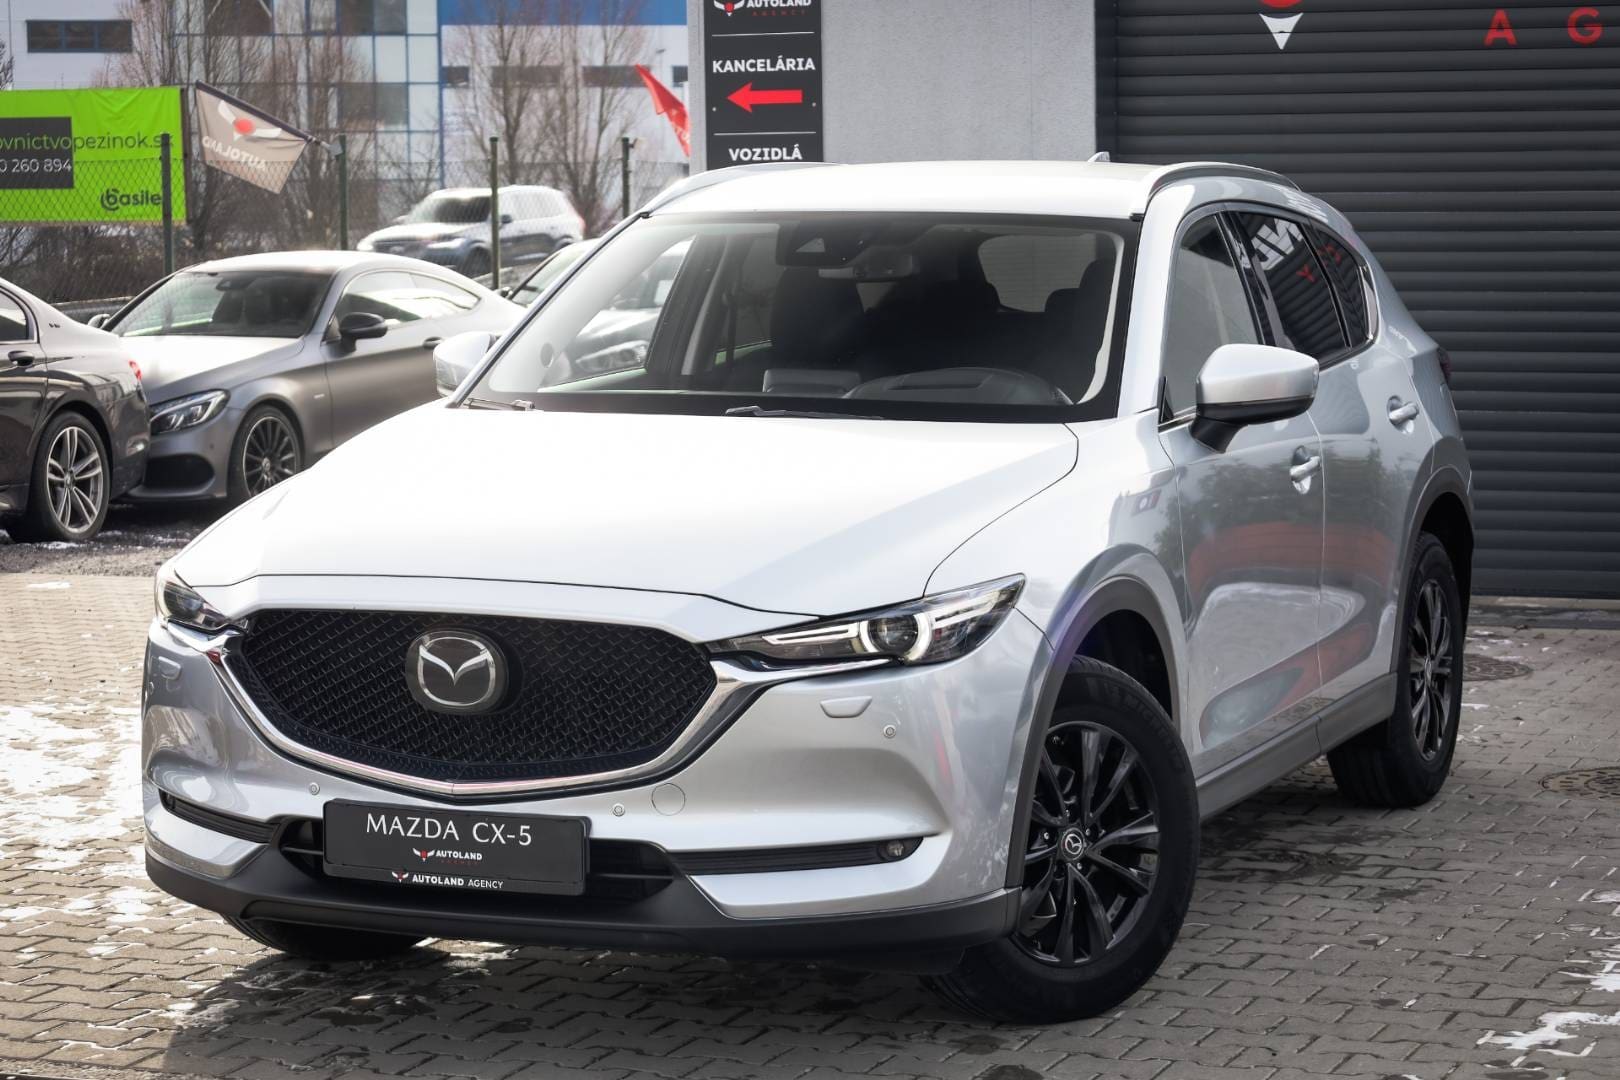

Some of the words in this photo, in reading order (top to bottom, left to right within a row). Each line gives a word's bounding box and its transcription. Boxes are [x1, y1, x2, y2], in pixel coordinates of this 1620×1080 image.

[712, 55, 816, 73] KANCELÁRIA
[728, 143, 803, 161] VOZIDLÁ
[11, 158, 40, 173] 260
[43, 158, 72, 173] 894
[366, 813, 460, 841] MAZDA
[471, 822, 532, 846] CX-5
[435, 849, 483, 861] AUTOLAND
[412, 874, 465, 886] AUTOLAND
[467, 877, 504, 889] AGENCY
